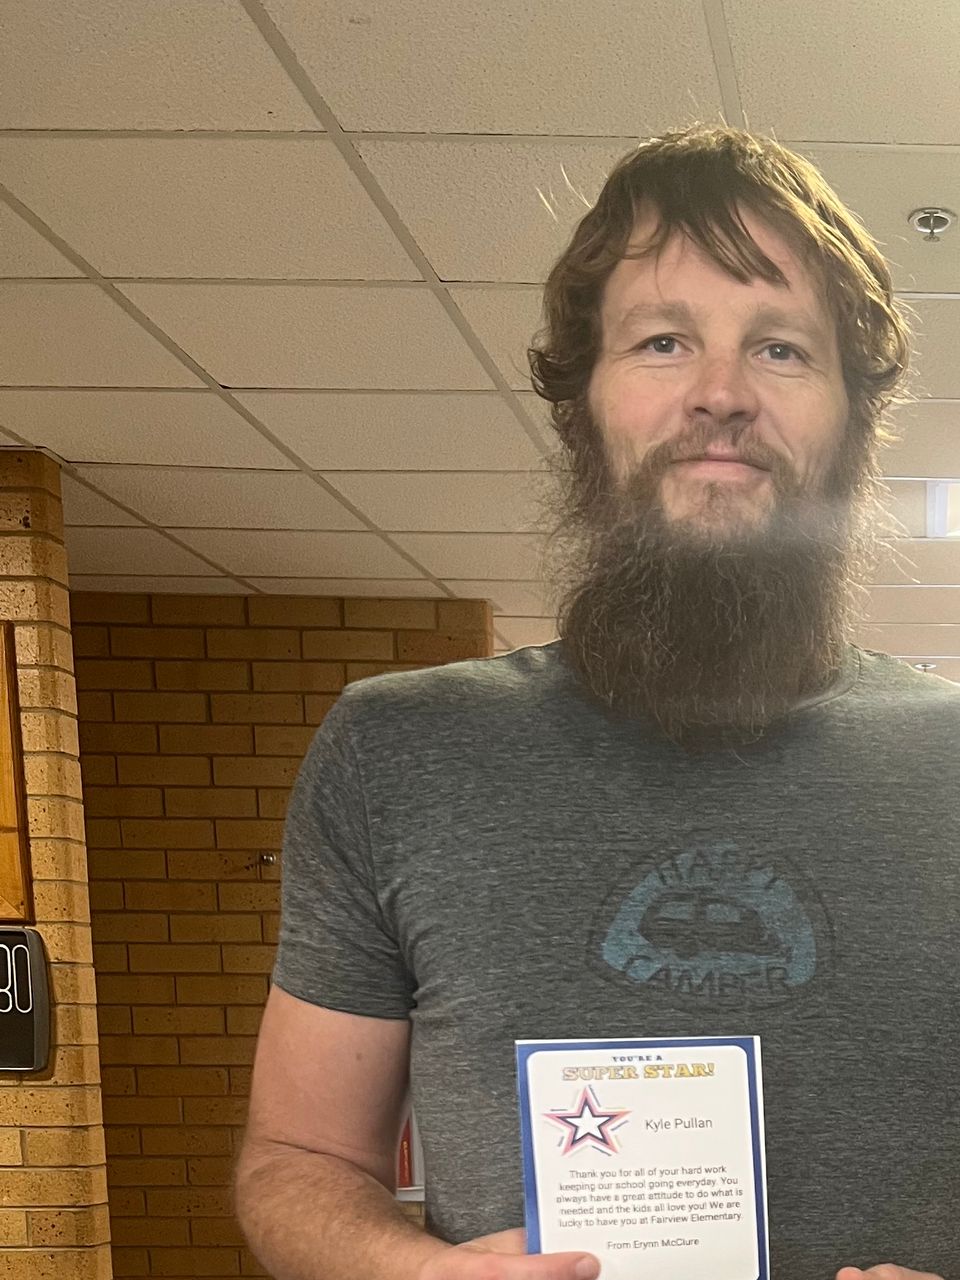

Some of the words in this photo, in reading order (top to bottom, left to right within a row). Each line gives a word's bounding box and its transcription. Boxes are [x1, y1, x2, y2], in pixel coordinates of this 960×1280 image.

[562, 1065, 639, 1081] SUPER
[643, 1063, 716, 1079] STAR!
[645, 1119, 671, 1132] Kyle
[675, 1118, 713, 1129] Pullan
[569, 1169, 598, 1179] Thank
[600, 1171, 617, 1180] you
[619, 1168, 632, 1177] for
[634, 1167, 646, 1177] all
[647, 1167, 657, 1176] of
[659, 1168, 679, 1177] your
[681, 1166, 703, 1175] hard
[704, 1165, 728, 1174] work
[559, 1182, 596, 1192] keeping
[615, 1180, 646, 1190] school
[648, 1181, 674, 1190] going
[720, 1176, 739, 1185] You
[556, 1195, 588, 1205] always
[590, 1193, 612, 1202] have
[614, 1194, 620, 1202] a
[622, 1193, 646, 1203] great
[648, 1191, 684, 1200] attitude
[685, 1191, 695, 1199] to
[696, 1190, 709, 1198] do
[711, 1188, 734, 1197] what
[735, 1188, 743, 1196] is
[560, 1206, 595, 1215] needed
[596, 1206, 614, 1215] and
[616, 1204, 631, 1213] the
[633, 1204, 652, 1213] kids
[654, 1203, 665, 1212] all
[667, 1203, 686, 1212] love
[688, 1202, 707, 1212] you!
[709, 1201, 725, 1209] We
[726, 1201, 741, 1209] are
[559, 1218, 583, 1229] lucky
[585, 1219, 595, 1227] to
[596, 1218, 619, 1227] have
[620, 1218, 638, 1228] you
[639, 1217, 649, 1225] at
[650, 1215, 688, 1225] Fairview
[607, 1240, 632, 1250] From
[633, 1239, 660, 1251] Erynn
[661, 1238, 700, 1247] McClure
